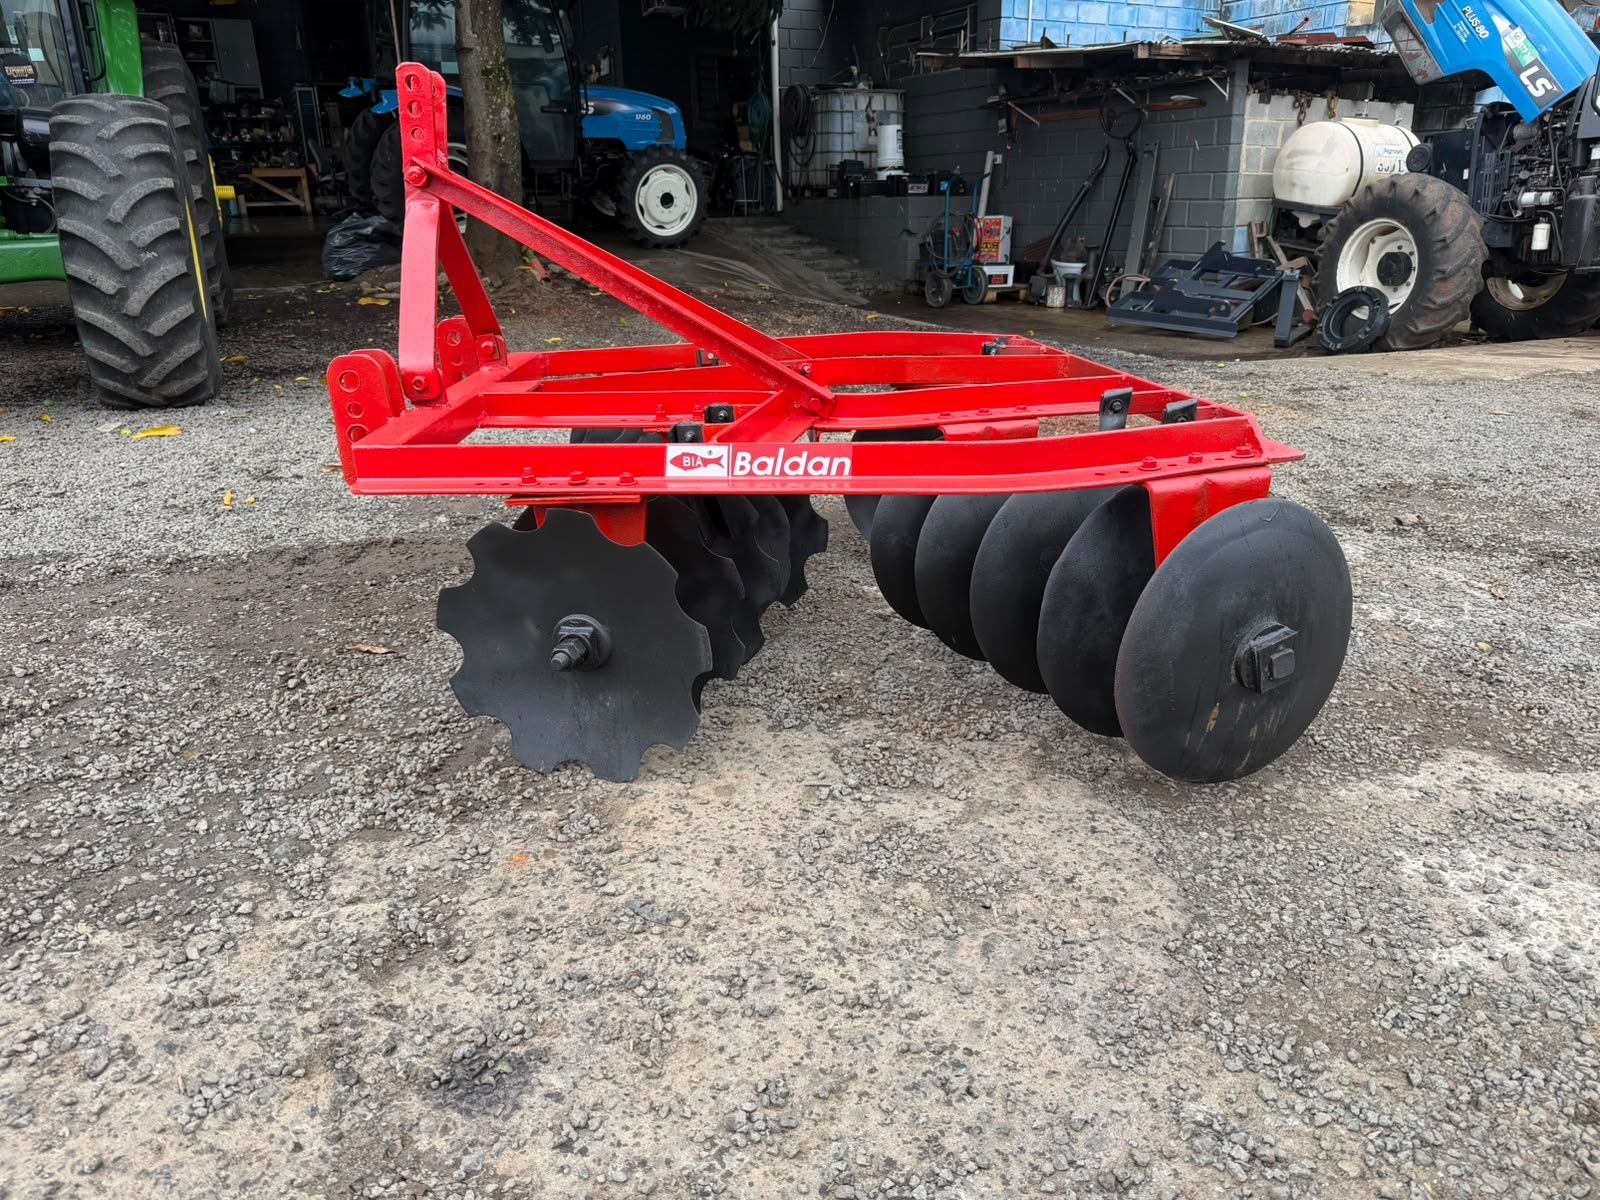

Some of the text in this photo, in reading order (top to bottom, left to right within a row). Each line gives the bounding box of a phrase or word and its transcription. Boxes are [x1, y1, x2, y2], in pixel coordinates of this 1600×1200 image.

[1519, 65, 1553, 97] LS
[635, 113, 652, 121] U60
[683, 447, 851, 476] BIA Baldan
